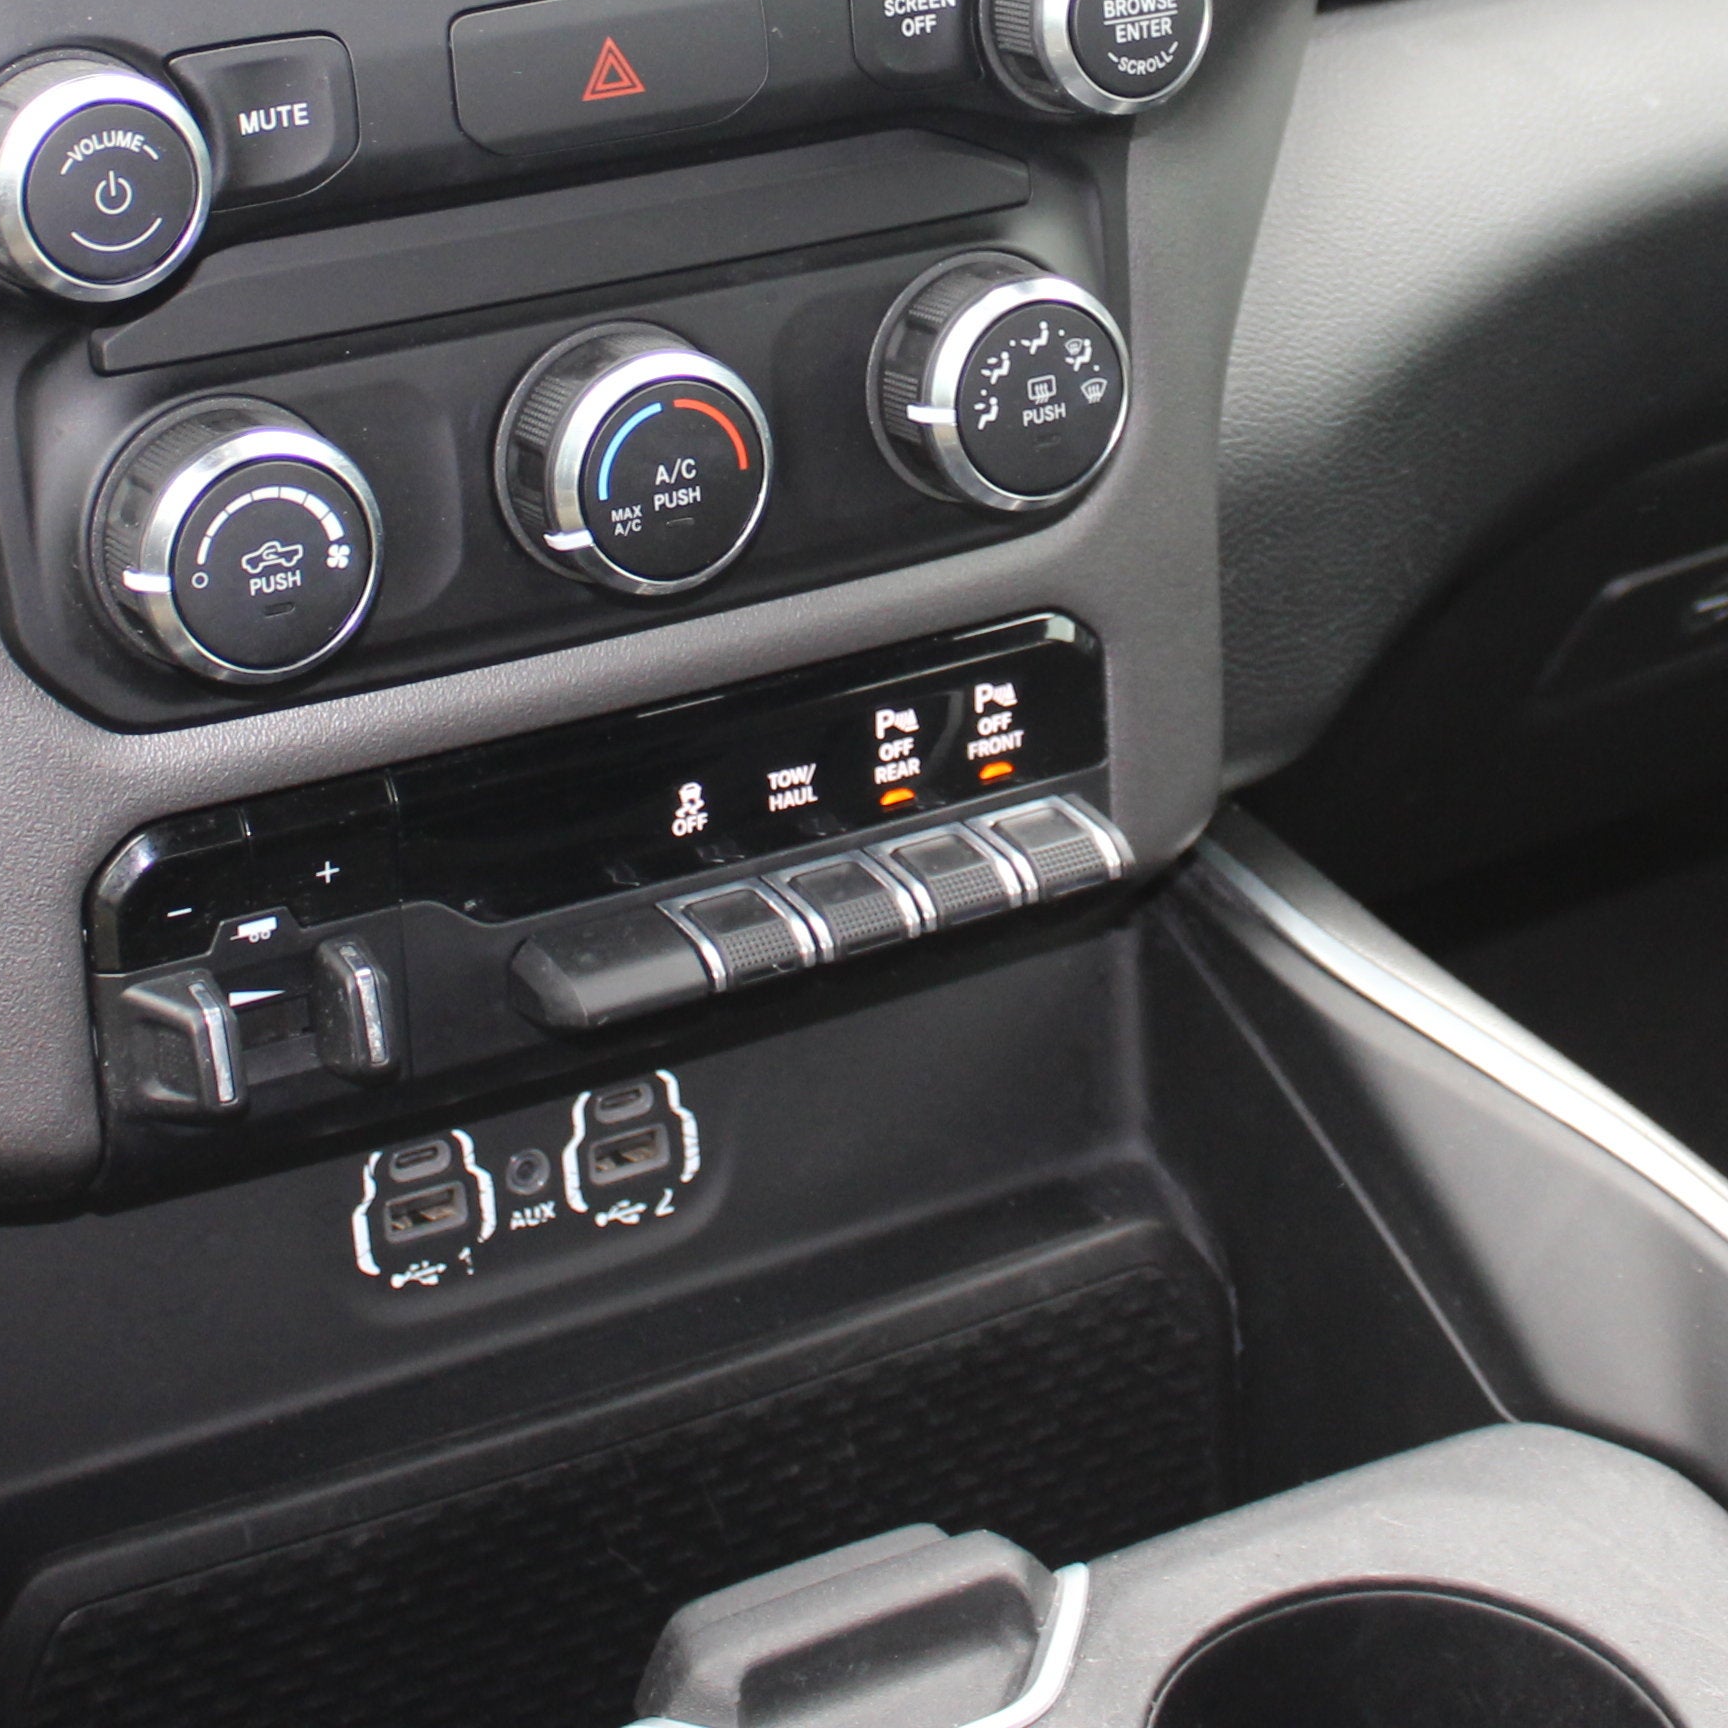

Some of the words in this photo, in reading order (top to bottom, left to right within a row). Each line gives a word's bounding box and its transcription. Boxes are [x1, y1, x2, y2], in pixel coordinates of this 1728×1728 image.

[901, 14, 937, 38] OFF
[1114, 17, 1173, 44] ENTER
[1117, 49, 1174, 76] SCROLL
[237, 102, 311, 137] MUTE
[66, 129, 145, 164] VOLUME
[1022, 402, 1067, 428] PUSH
[654, 457, 698, 486] A/C
[653, 485, 702, 512] PUSH
[610, 503, 643, 523] MAX
[613, 518, 643, 537] A/C
[249, 569, 302, 597] PUSH
[976, 710, 1013, 736] OFF
[878, 737, 914, 762] OFF
[967, 729, 1024, 760] FRONT
[767, 763, 817, 790] TOW/
[874, 757, 921, 784] REAR
[768, 785, 818, 812] HAUL
[671, 812, 709, 837] OFF
[509, 1201, 556, 1231] AUX
